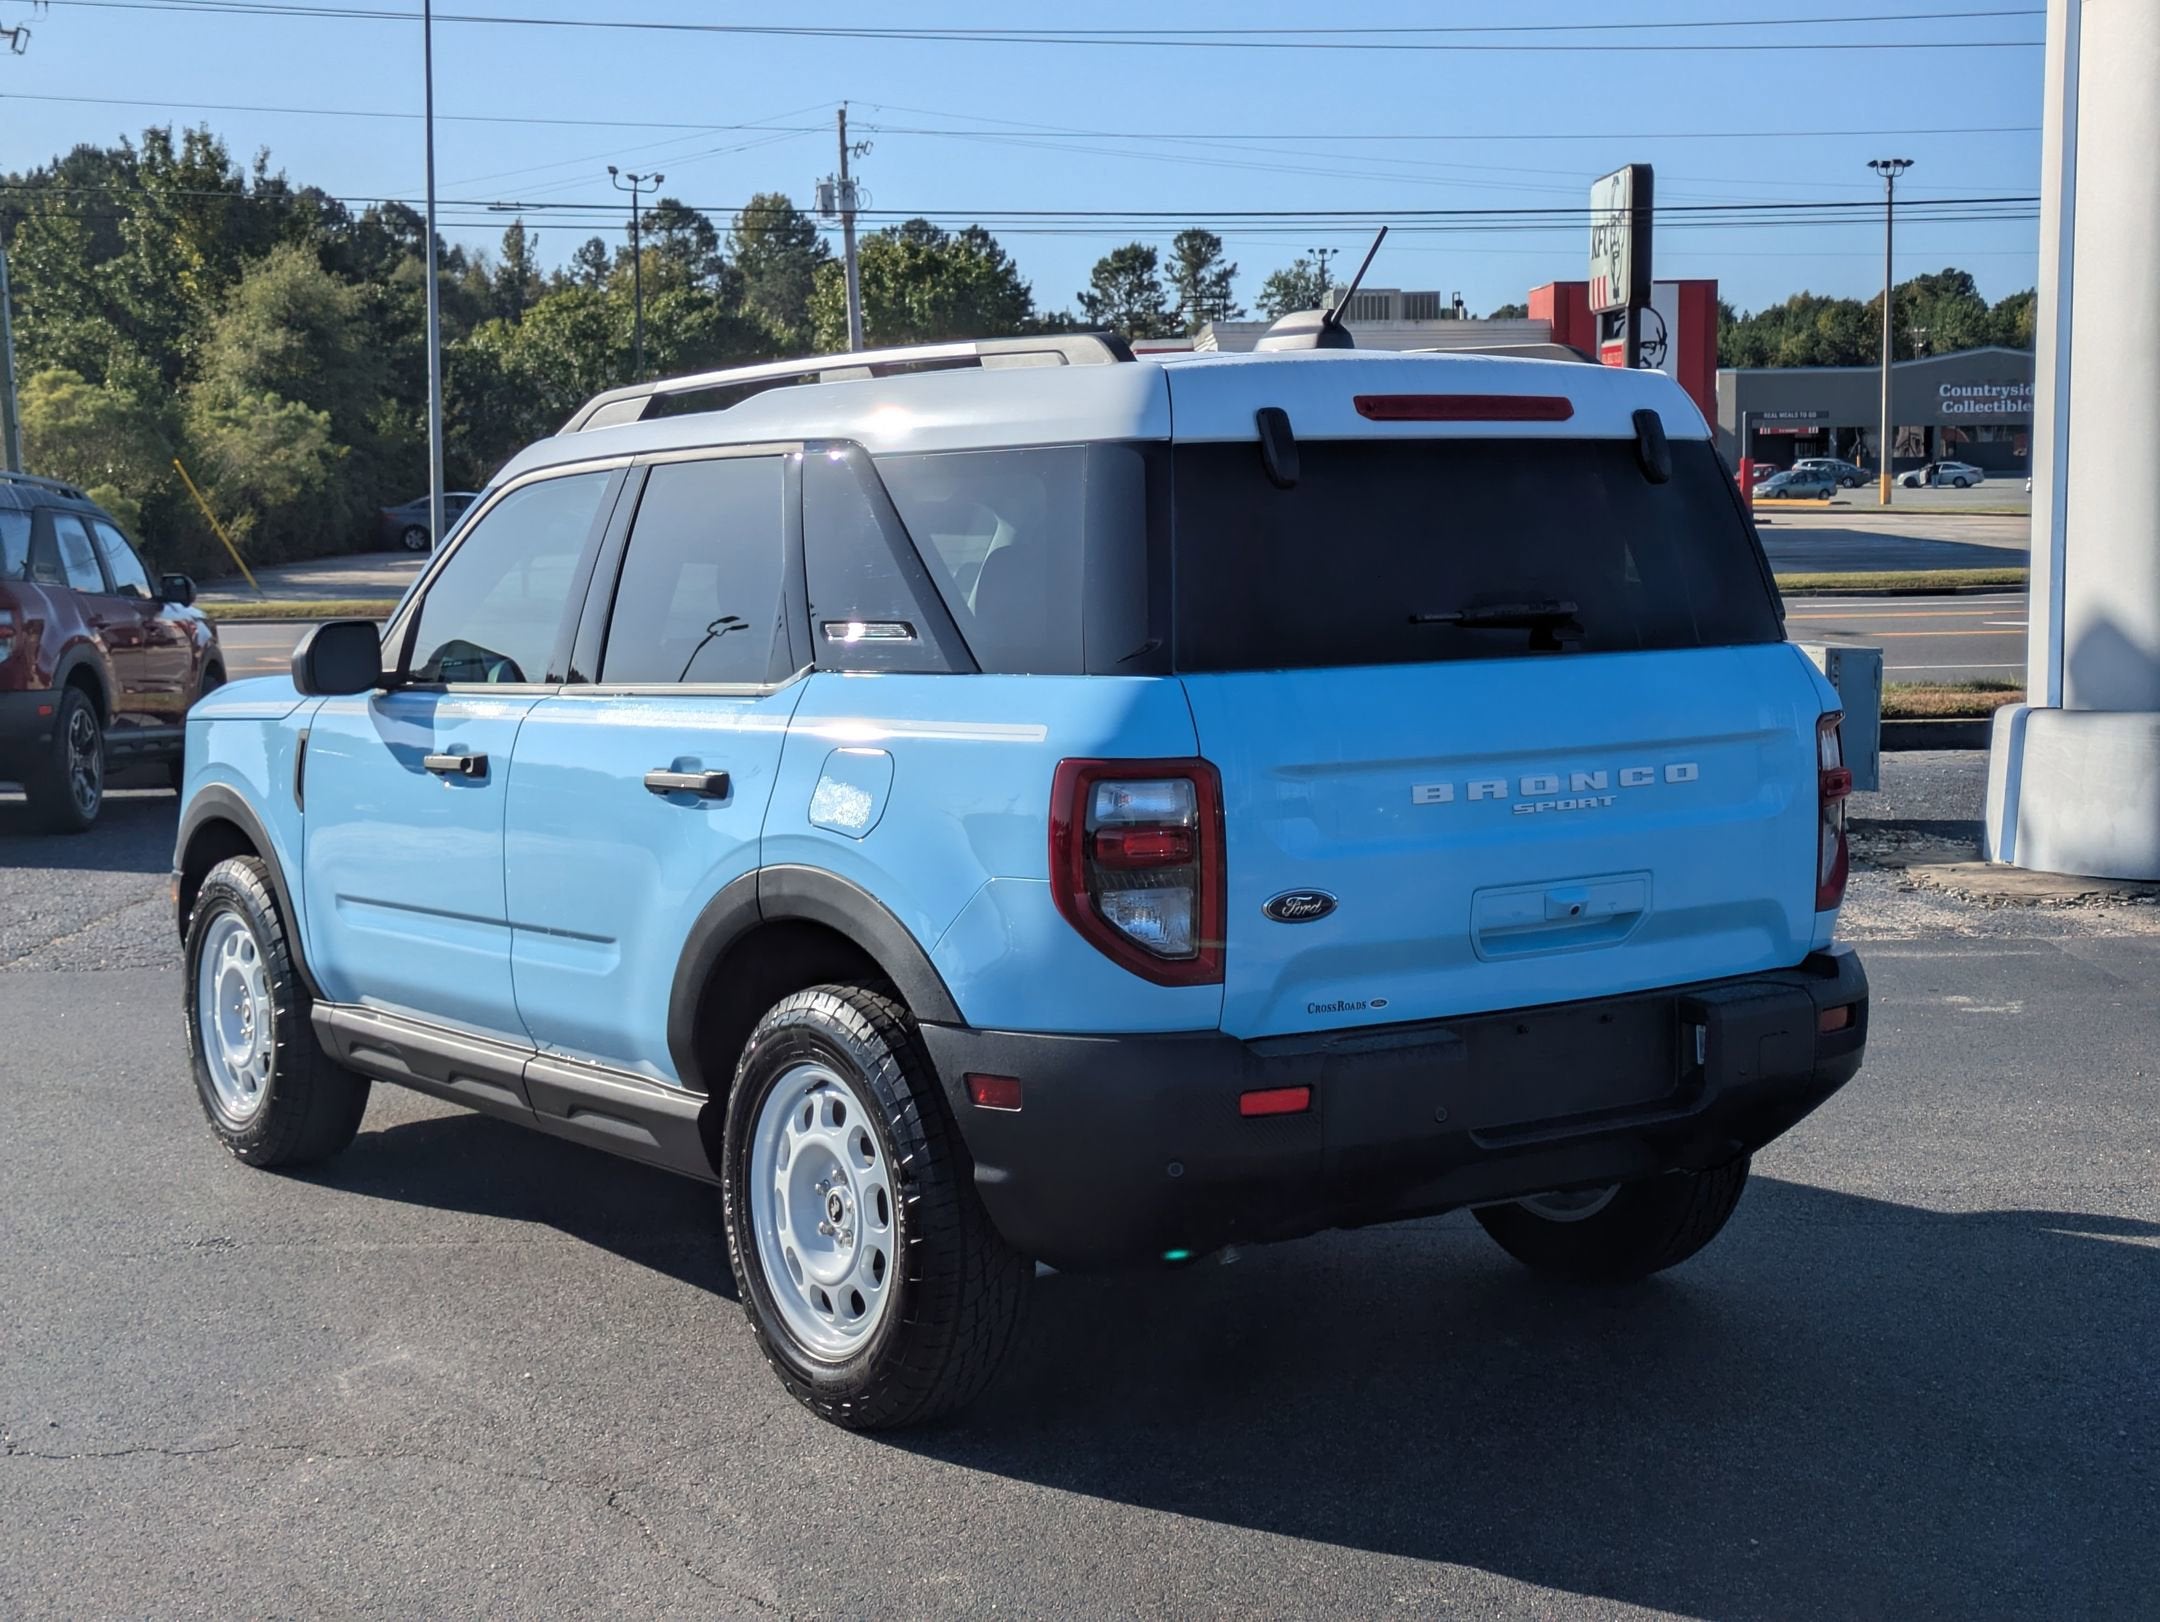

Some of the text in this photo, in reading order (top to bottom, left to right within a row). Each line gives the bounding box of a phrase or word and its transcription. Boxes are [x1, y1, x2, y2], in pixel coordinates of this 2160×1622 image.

[1591, 222, 1609, 260] KFC
[1942, 400, 2034, 413] Collectible
[1411, 763, 1699, 804] BRONCO
[1512, 795, 1617, 815] SPORT
[1282, 896, 1322, 917] Ford
